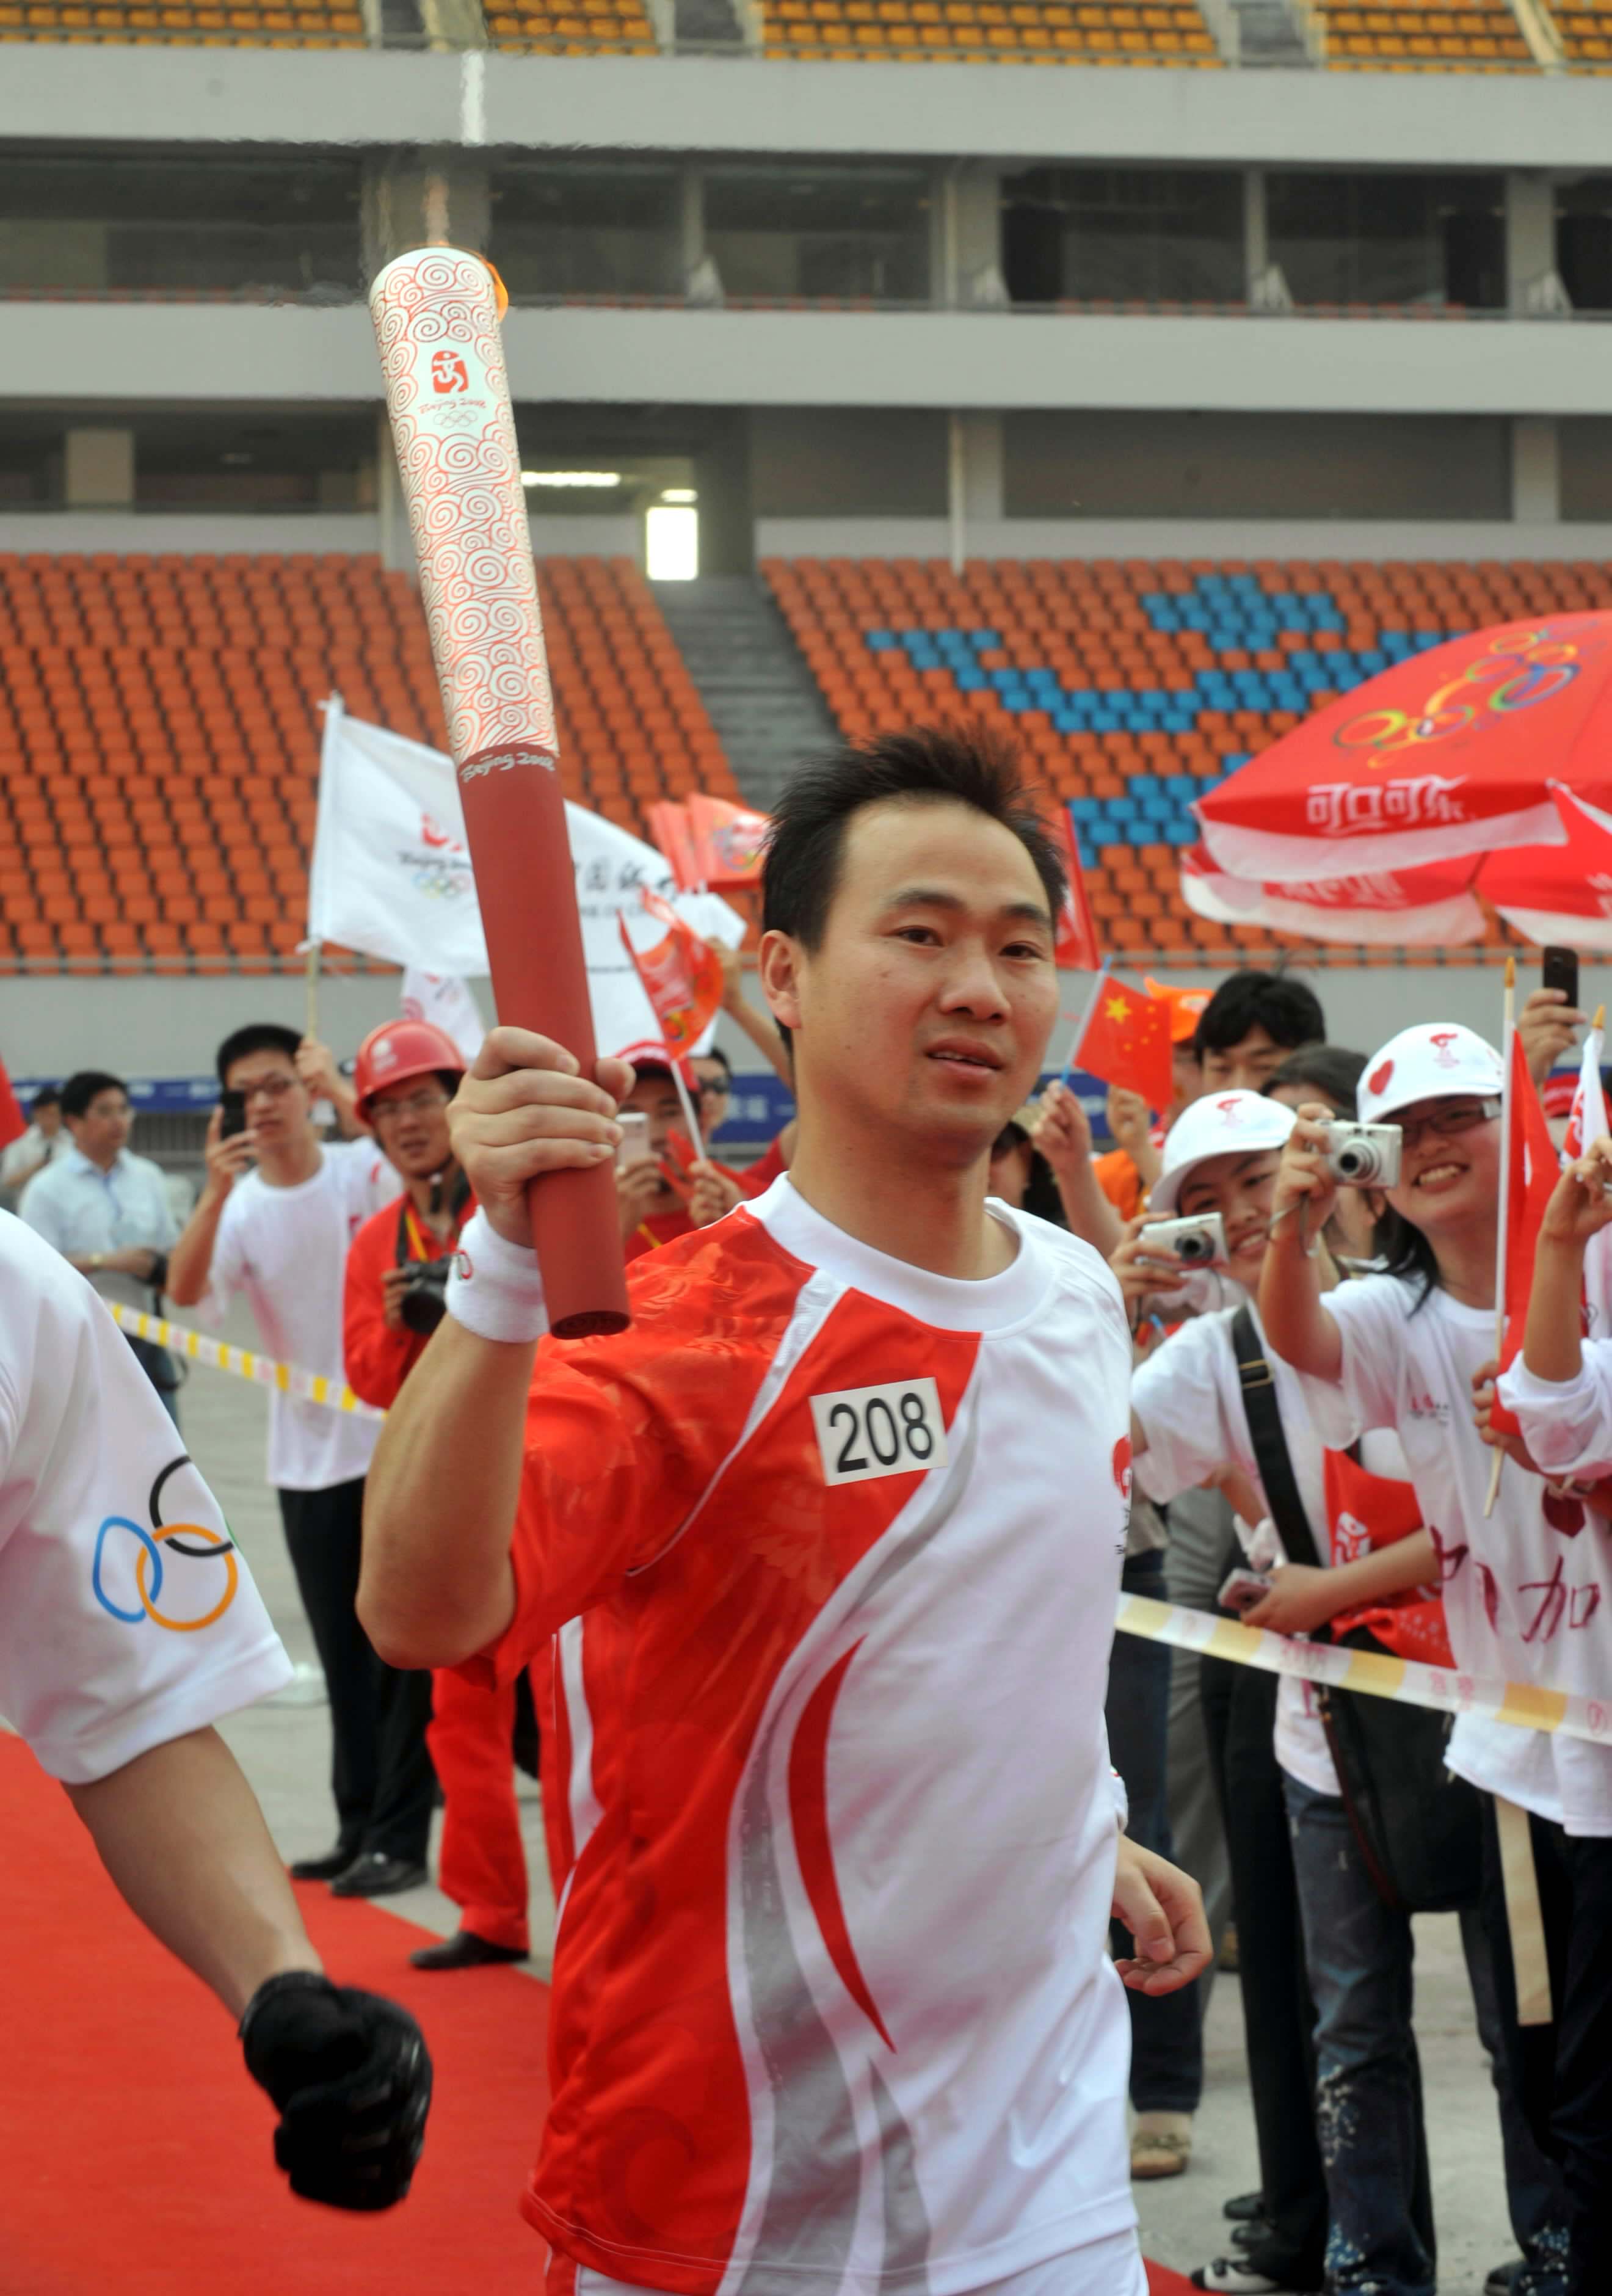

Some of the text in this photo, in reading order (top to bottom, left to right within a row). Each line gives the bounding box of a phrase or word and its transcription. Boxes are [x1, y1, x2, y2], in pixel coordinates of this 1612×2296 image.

[459, 752, 556, 783] Beijing 2008
[1306, 773, 1470, 835] 可口可乐
[829, 1392, 934, 1473] 208
